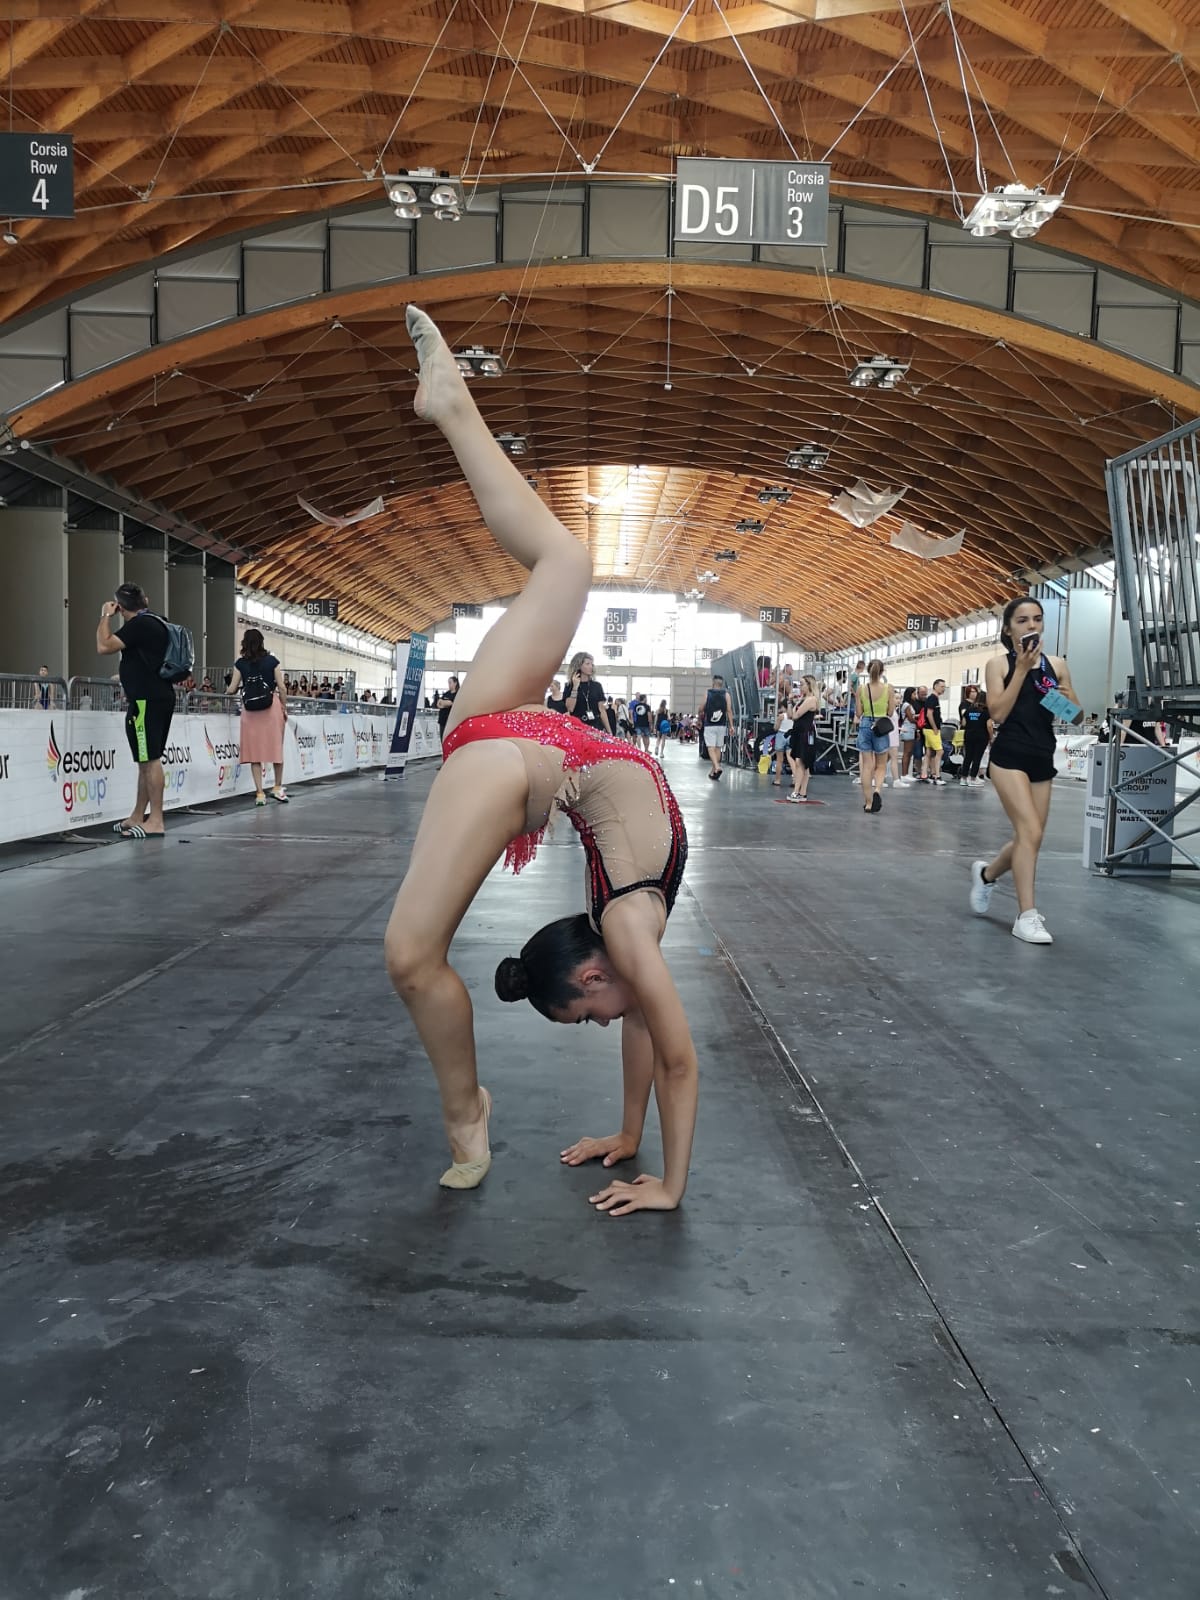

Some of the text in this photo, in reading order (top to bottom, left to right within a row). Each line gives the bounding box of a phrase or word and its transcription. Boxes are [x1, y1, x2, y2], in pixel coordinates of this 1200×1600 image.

[30, 141, 68, 156] Corsia
[30, 159, 57, 174] Row
[787, 169, 824, 185] Corsia
[31, 178, 50, 210] 4
[787, 188, 814, 203] Row
[680, 184, 739, 236] D5
[786, 206, 803, 239] 3
[307, 603, 320, 615] B5
[607, 611, 620, 623] B5
[759, 610, 772, 622] B5
[907, 618, 920, 630] B5
[161, 742, 192, 765] satour
[215, 740, 240, 760] esato
[1068, 749, 1088, 758] esatou
[62, 744, 116, 774] esatour
[164, 768, 185, 793] oup
[62, 778, 107, 812] group
